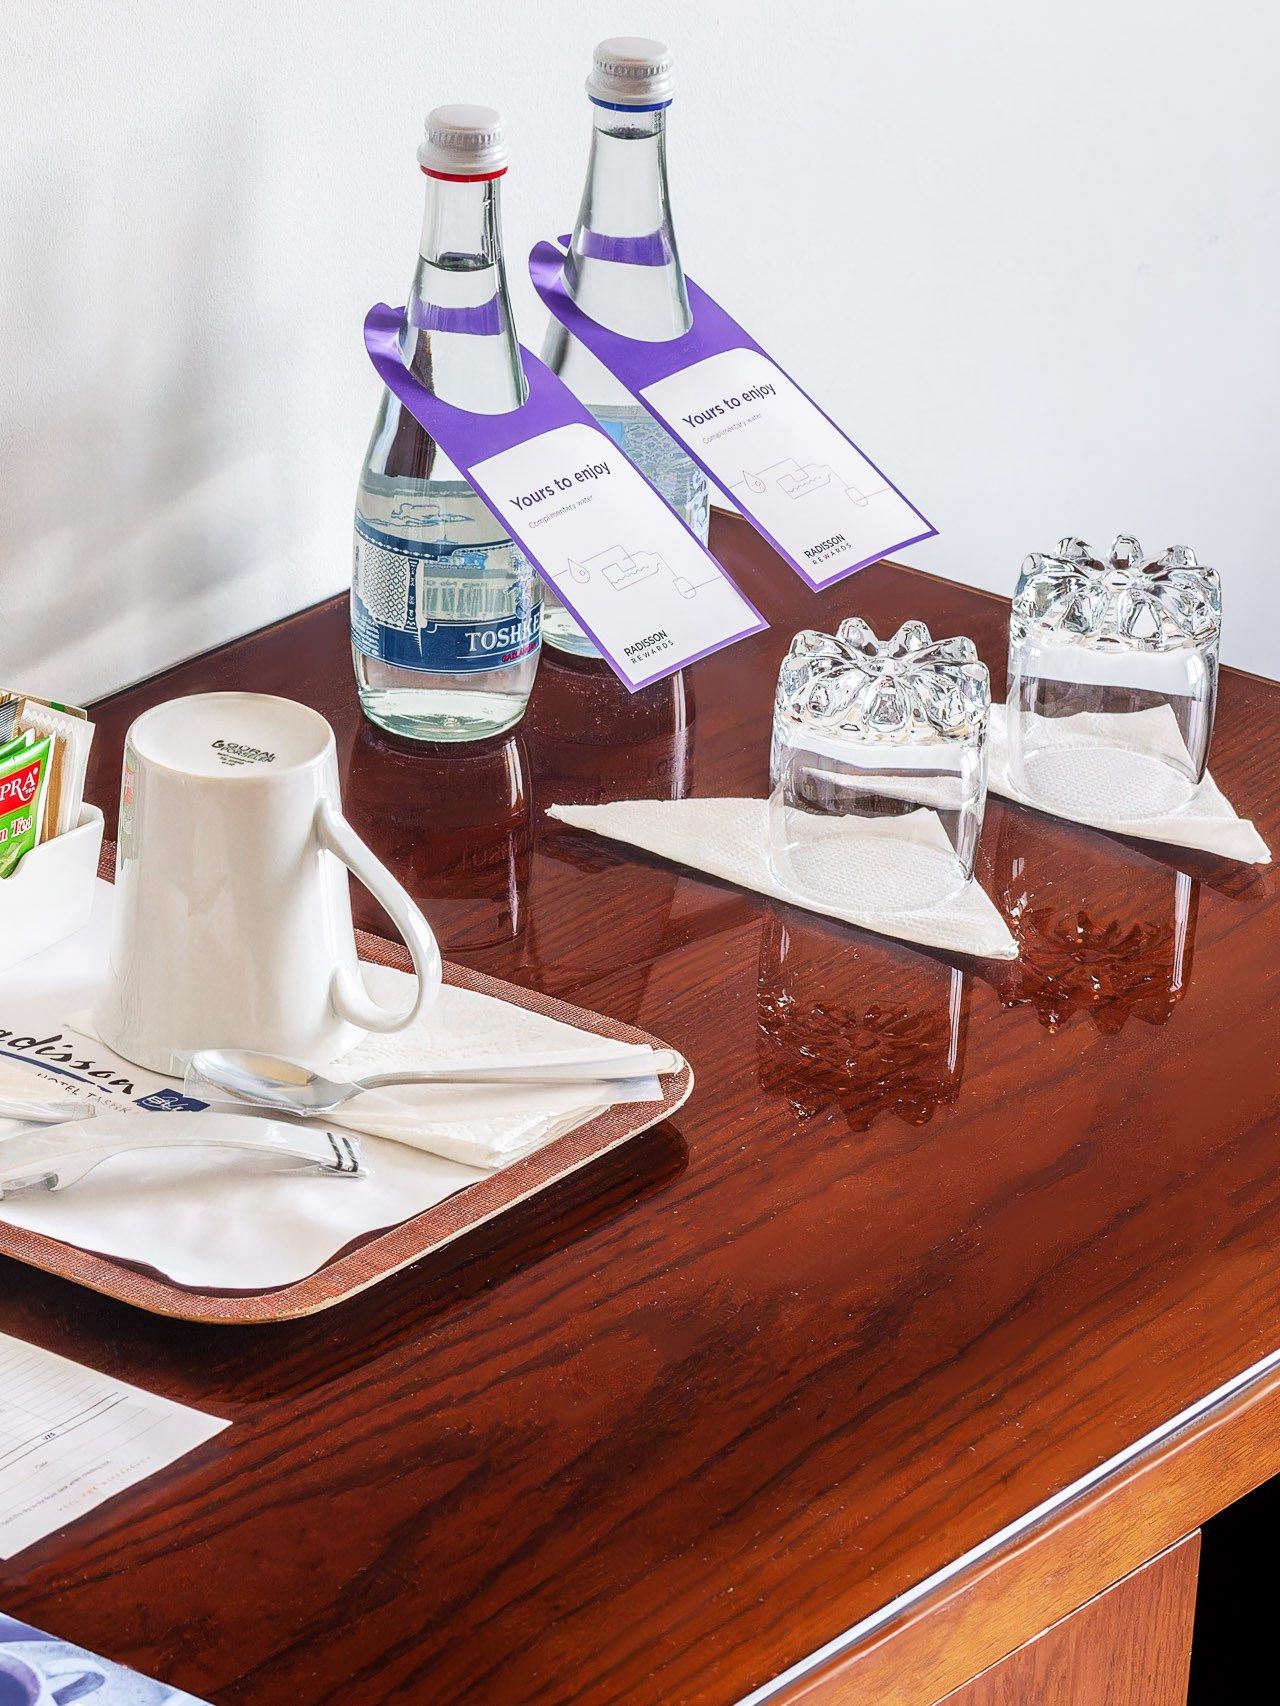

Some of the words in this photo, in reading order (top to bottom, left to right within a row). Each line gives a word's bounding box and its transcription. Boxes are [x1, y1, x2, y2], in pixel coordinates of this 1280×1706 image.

[682, 405, 725, 428] Yours
[722, 397, 741, 410] to
[742, 383, 776, 402] enjoy
[702, 421, 747, 444] Complimentary
[509, 485, 555, 511] Yours
[553, 477, 573, 491] to
[574, 461, 611, 483] enjoy
[528, 503, 577, 529] Complimentary
[803, 533, 846, 558] RADISSON
[812, 542, 852, 565] REWARDS
[623, 629, 668, 657] RADISSON
[630, 639, 674, 665] REWARDS
[11, 815, 33, 838] Tea
